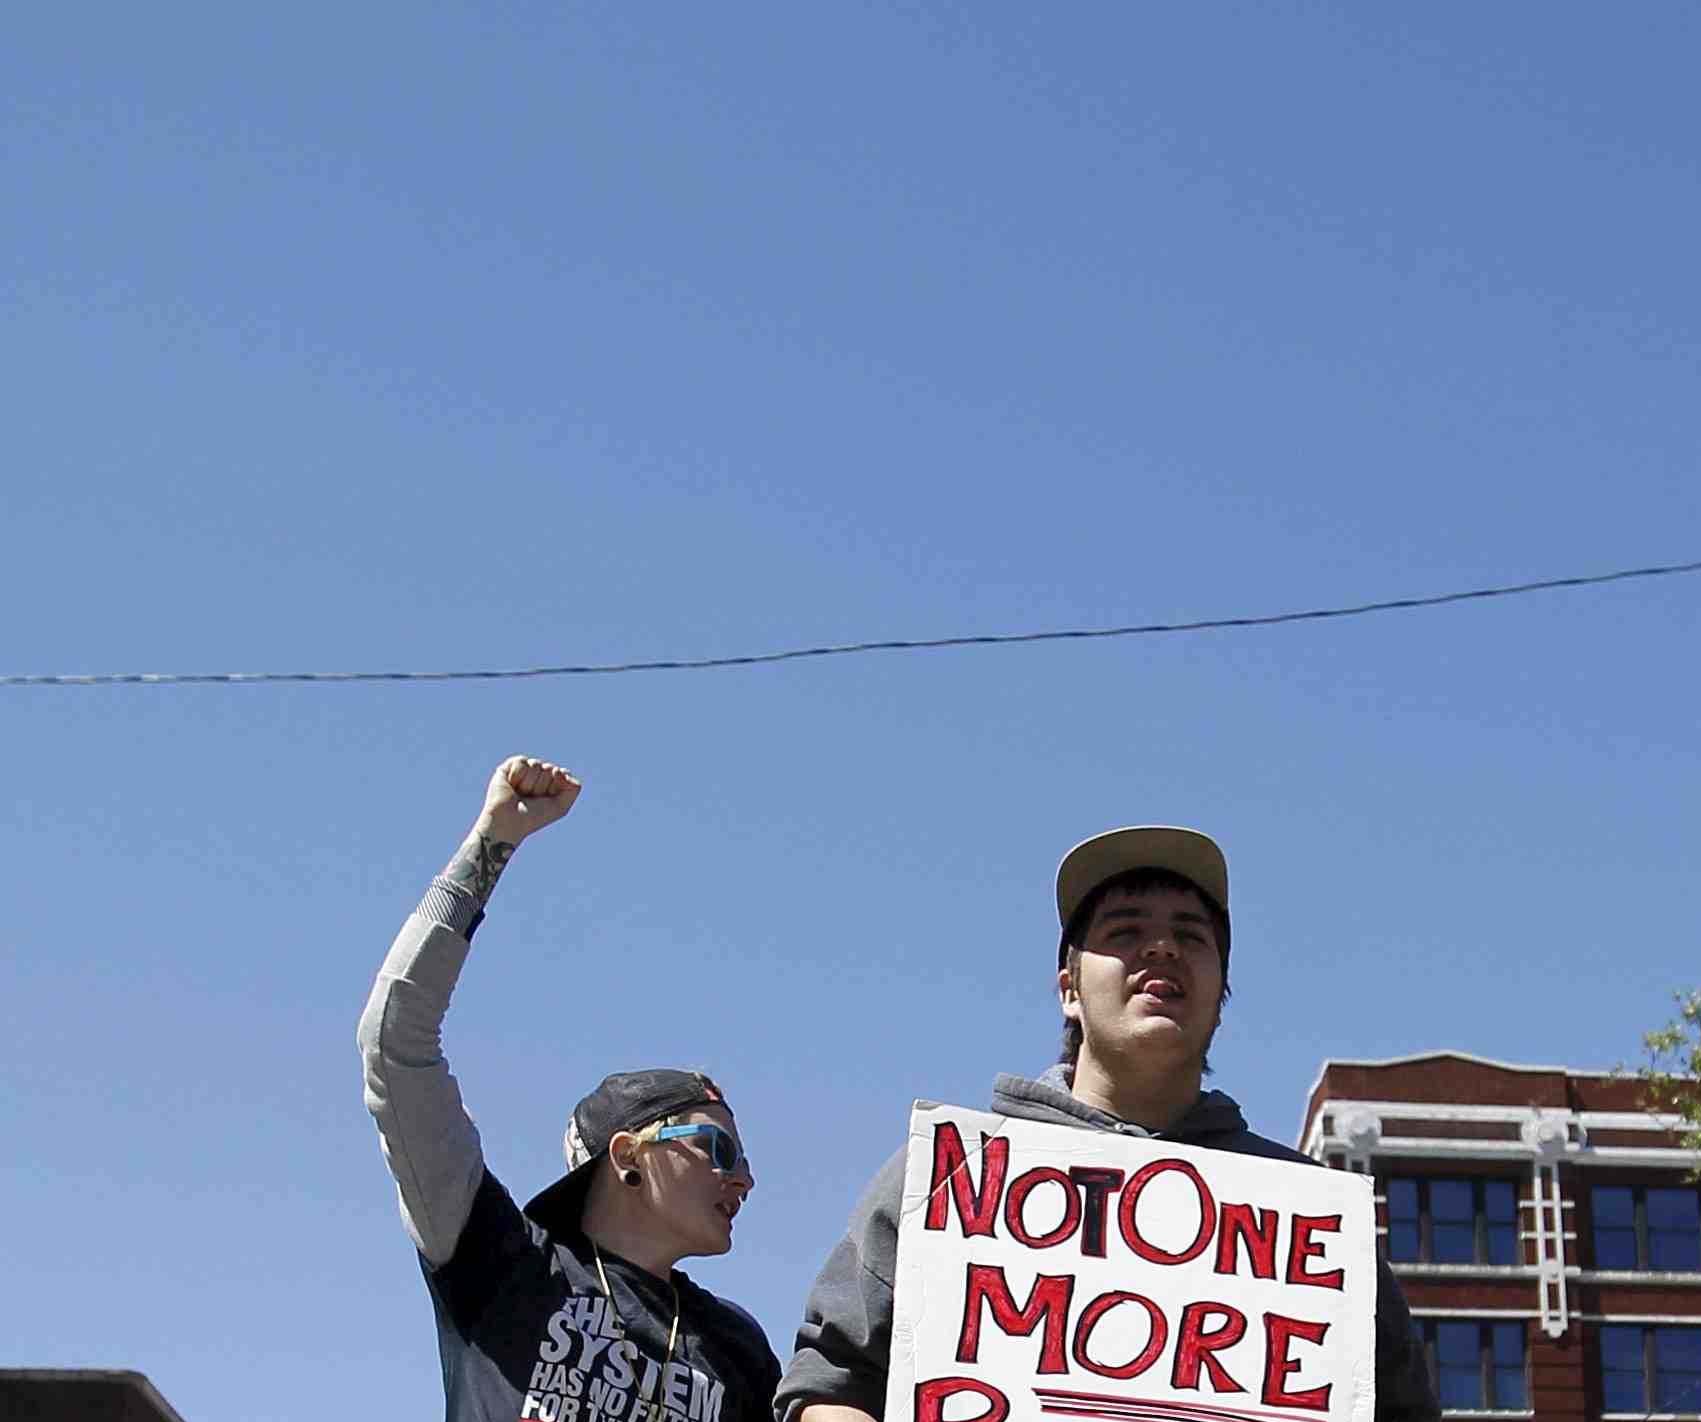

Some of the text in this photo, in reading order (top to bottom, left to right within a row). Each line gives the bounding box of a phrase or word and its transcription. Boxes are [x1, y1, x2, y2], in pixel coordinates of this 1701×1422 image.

[956, 1263, 1332, 1411] MORE
[529, 1361, 585, 1398] HAS
[589, 1377, 628, 1417] NO
